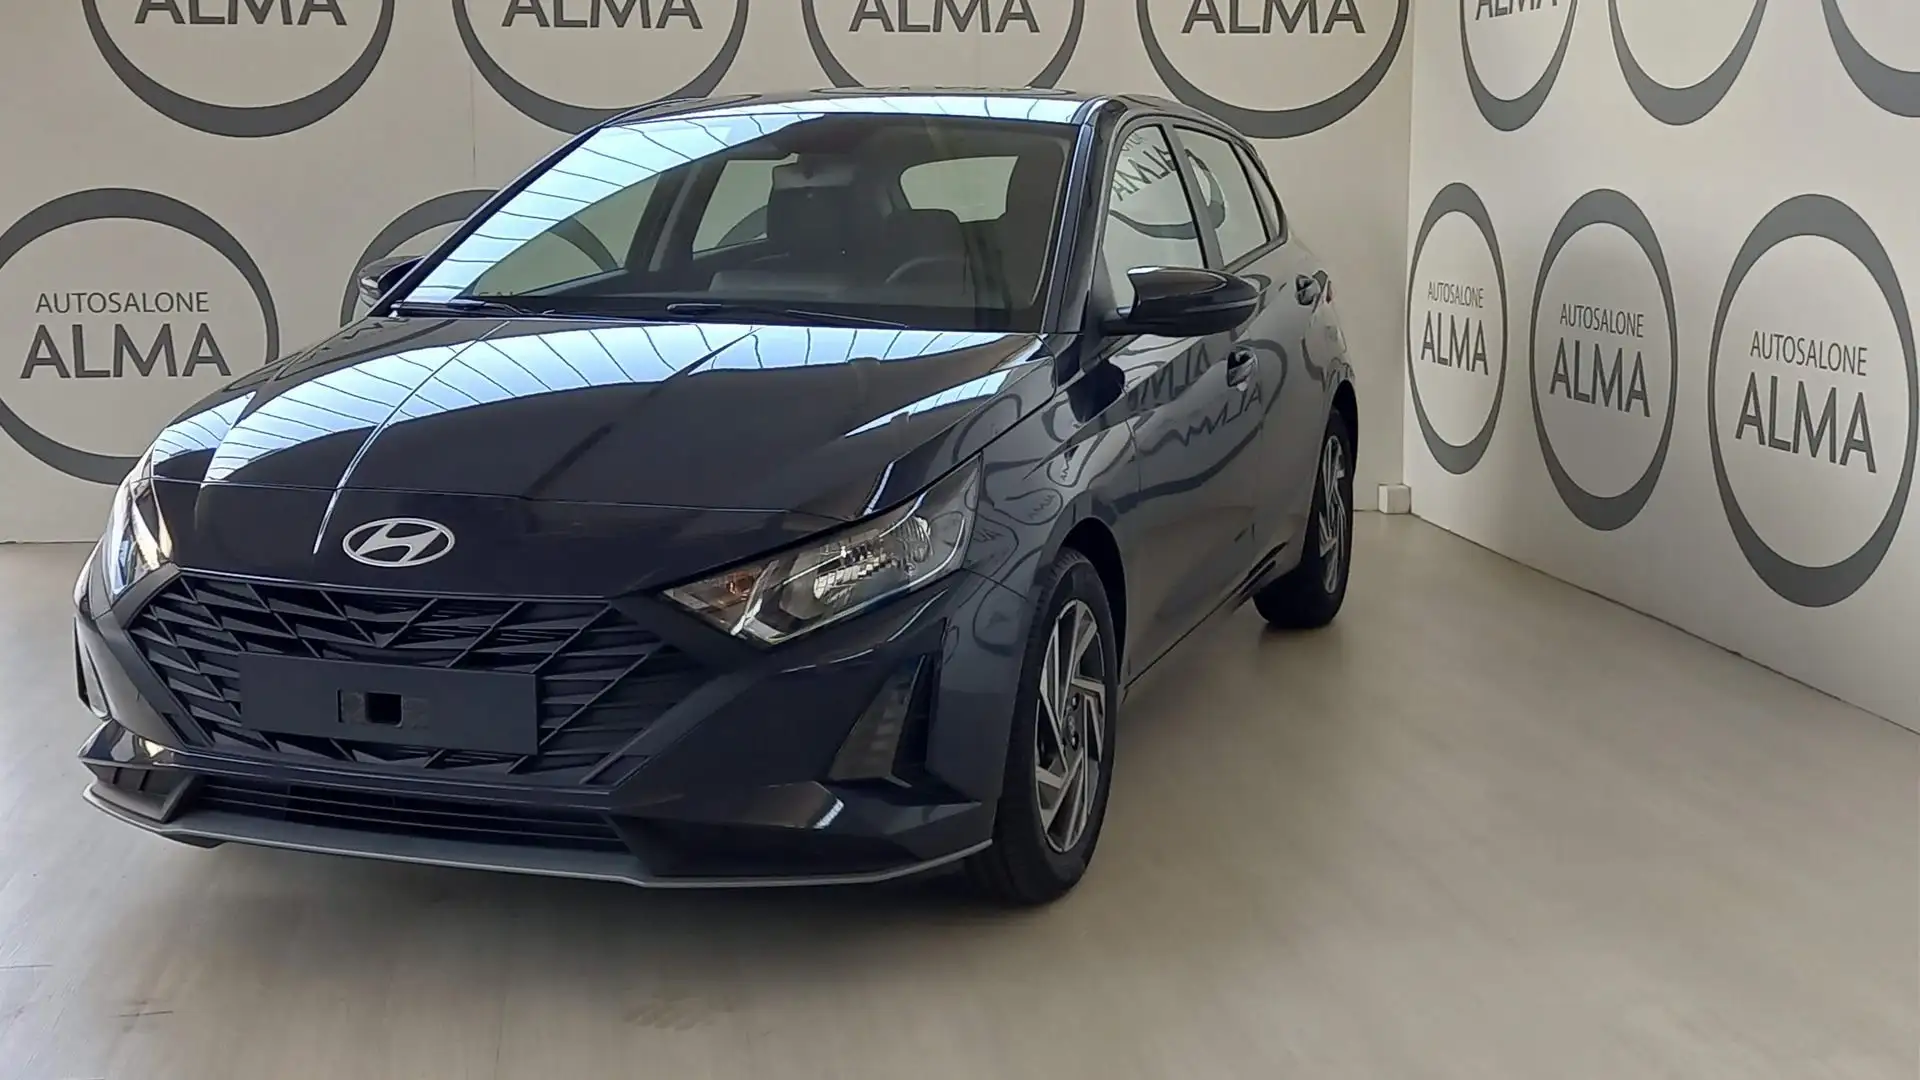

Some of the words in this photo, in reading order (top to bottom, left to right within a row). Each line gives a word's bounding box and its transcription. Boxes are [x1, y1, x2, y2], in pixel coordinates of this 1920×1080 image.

[849, 0, 1041, 33] ALMA
[1182, 0, 1366, 34] ALMA
[35, 291, 209, 314] AUTOSALONE
[1427, 281, 1484, 309] AUTOSALONE
[1559, 303, 1645, 338] AUTOSALONE
[20, 323, 232, 379] ALMA
[1420, 311, 1489, 376] ALMA
[1750, 330, 1868, 377] AUTOSALONE
[1549, 337, 1651, 418] ALMA
[1735, 371, 1877, 474] ALMA
